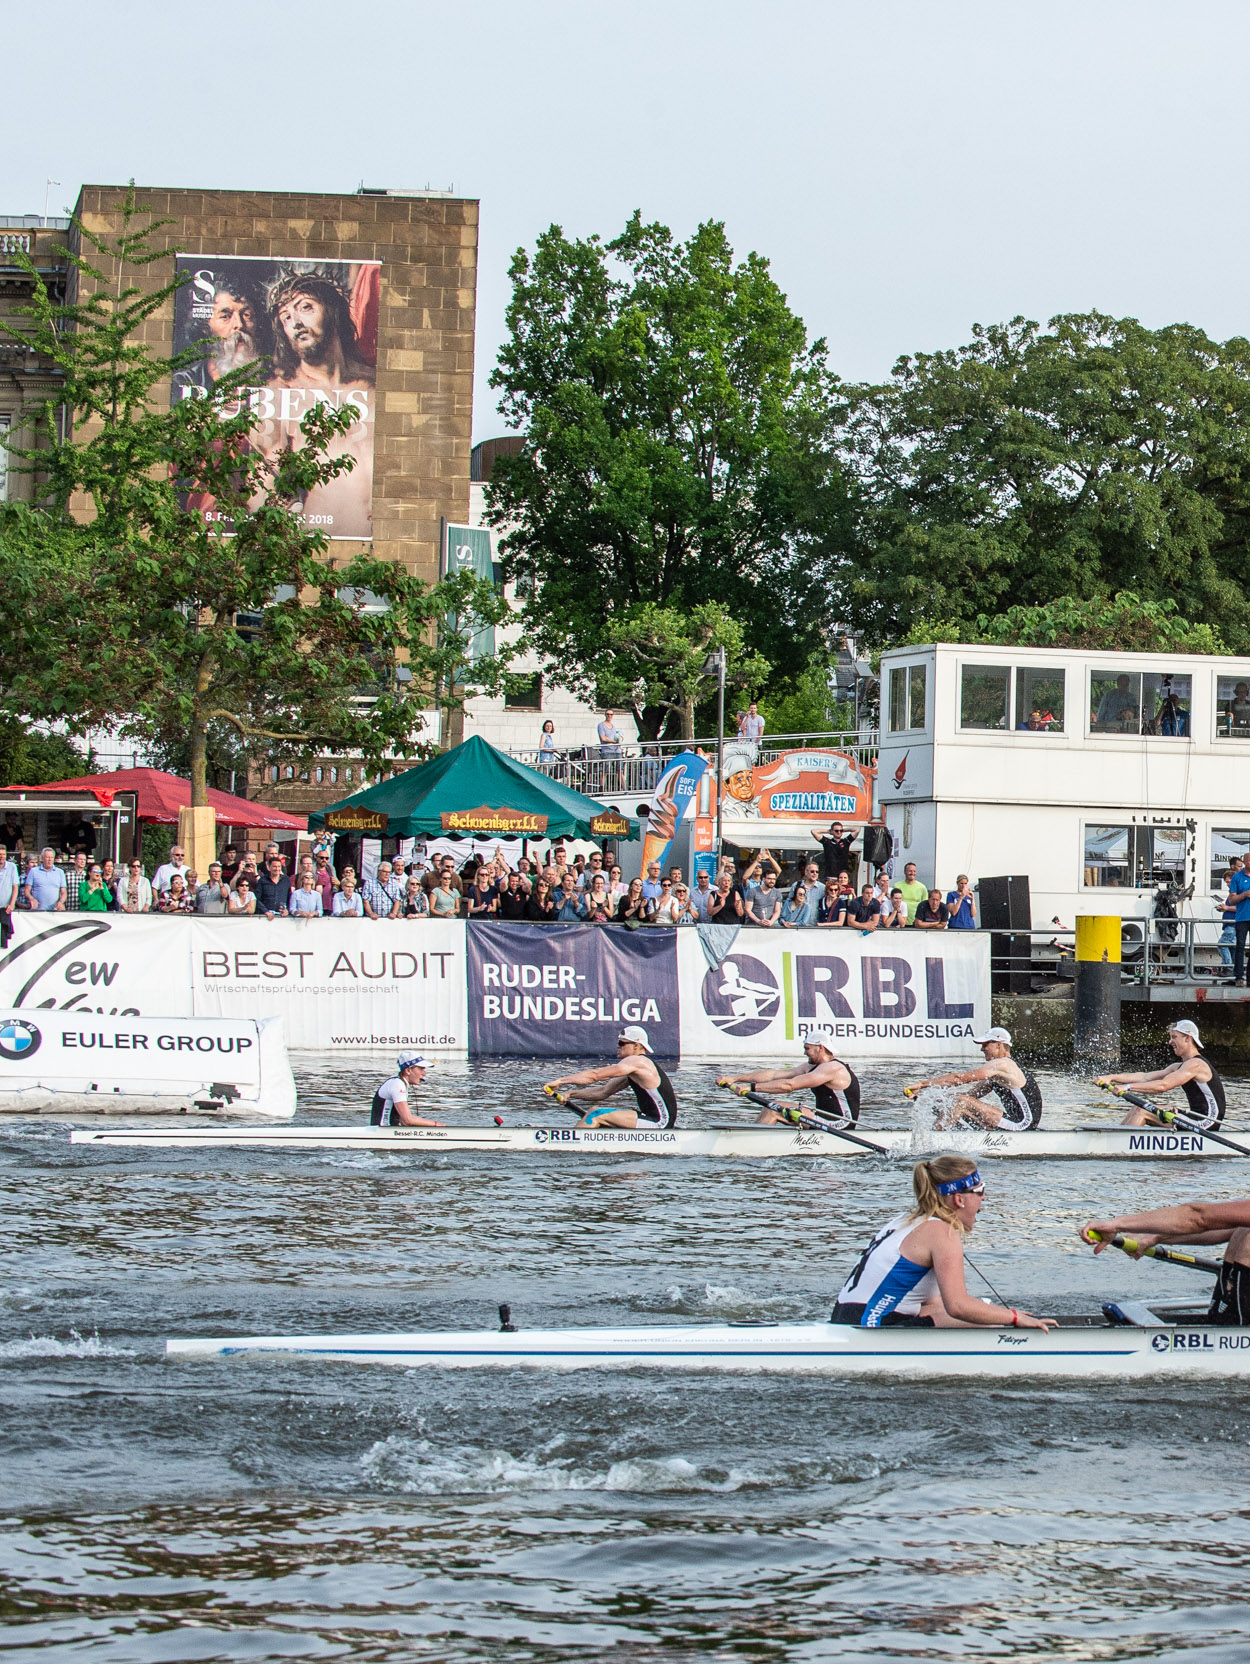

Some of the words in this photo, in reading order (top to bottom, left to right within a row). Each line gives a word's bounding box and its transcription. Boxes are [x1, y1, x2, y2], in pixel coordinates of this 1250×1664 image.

[309, 514, 334, 525] 2018
[680, 776, 696, 785] SOFT
[770, 792, 856, 813] SPEZIALITÄTEN
[448, 812, 539, 831] Schwenkgrill
[203, 951, 314, 978] BEST
[328, 951, 455, 979] AUDIT
[482, 963, 586, 989] RUDER-
[204, 984, 399, 995] Wirtschaftsprüfungsgesellschaft
[796, 955, 974, 1020] RBL
[483, 994, 662, 1023] BUNDESLIGA
[62, 1031, 149, 1050] EULER
[157, 1035, 253, 1054] GROUP
[331, 1034, 456, 1045] www.bestaudit.de
[550, 1130, 580, 1141] RBL
[583, 1132, 676, 1142] RUDER-BUNDESLIGA
[790, 1133, 822, 1147] Melitta
[980, 1132, 1010, 1148] Melitta
[1129, 1135, 1204, 1151] MINDEN
[1173, 1334, 1214, 1348] RBL
